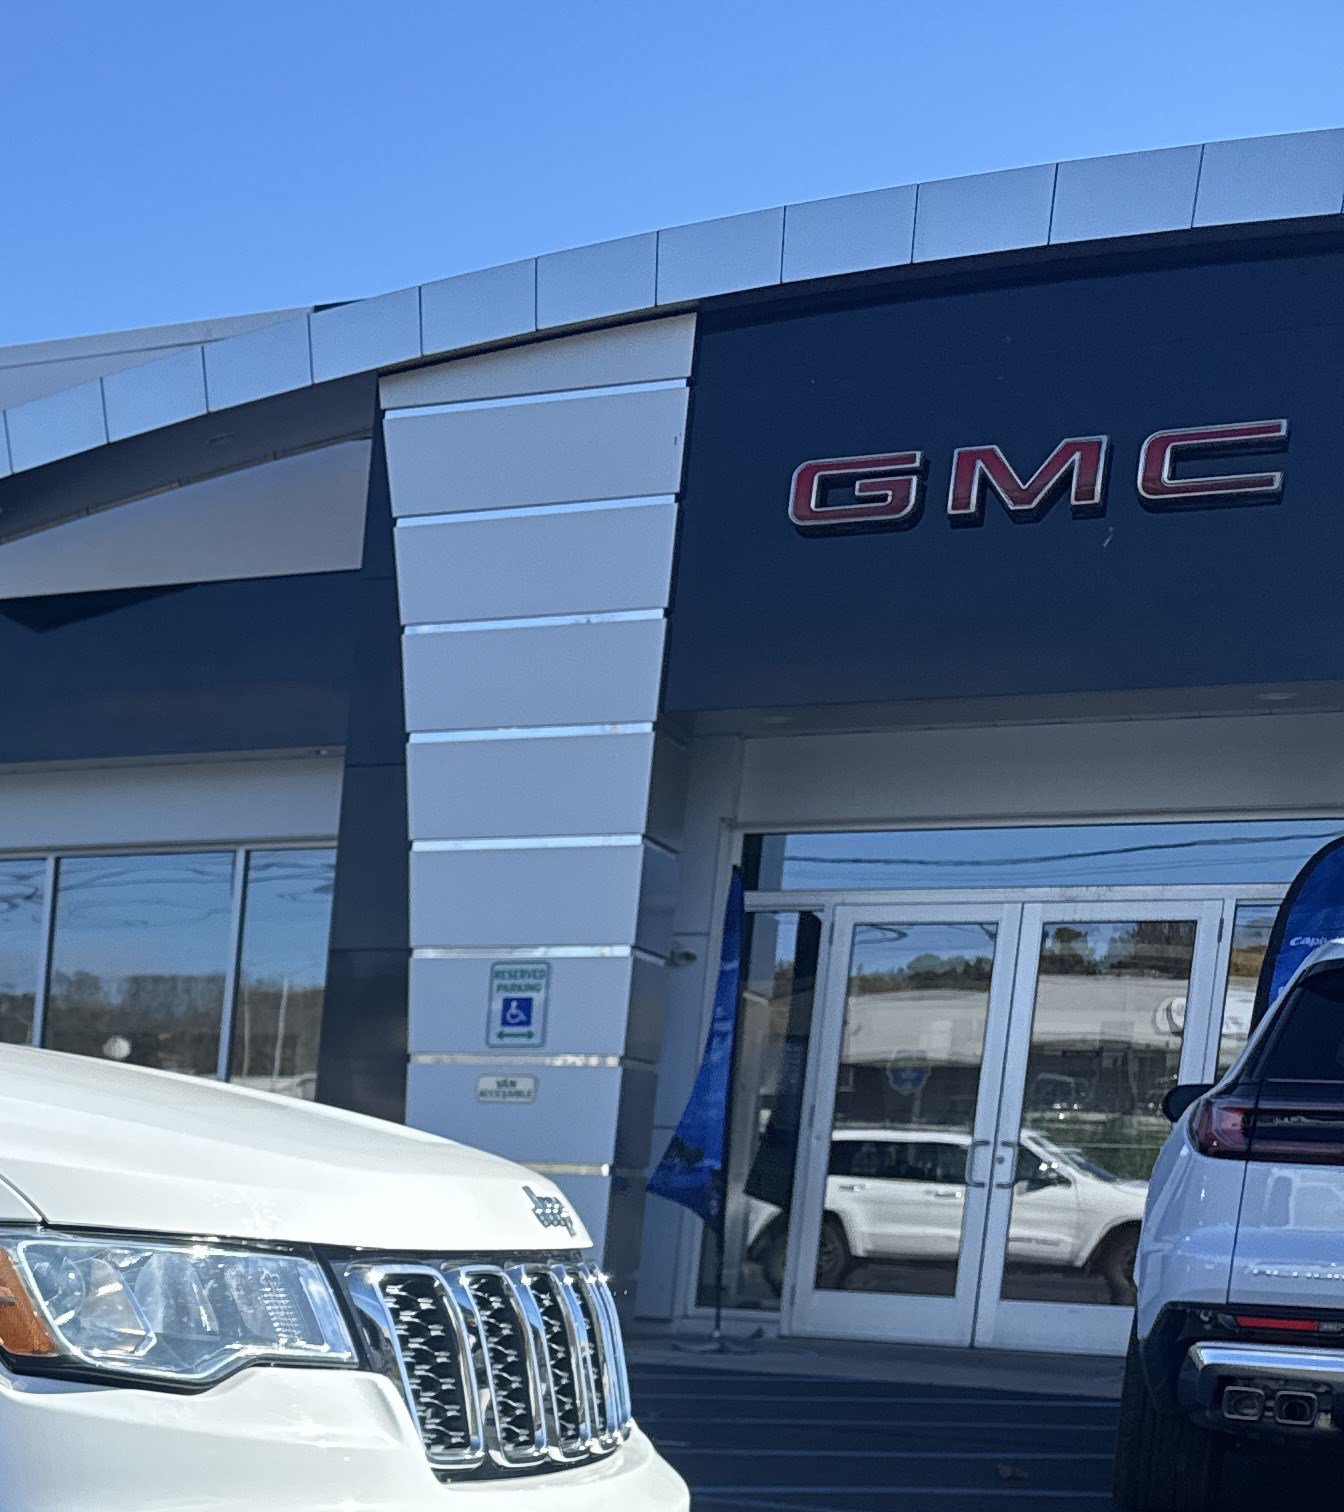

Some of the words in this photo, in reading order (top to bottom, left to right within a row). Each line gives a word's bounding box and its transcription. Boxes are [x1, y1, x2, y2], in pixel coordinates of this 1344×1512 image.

[787, 418, 1290, 530] GMC
[494, 968, 546, 981] RESERVED
[495, 982, 542, 993] PARKING
